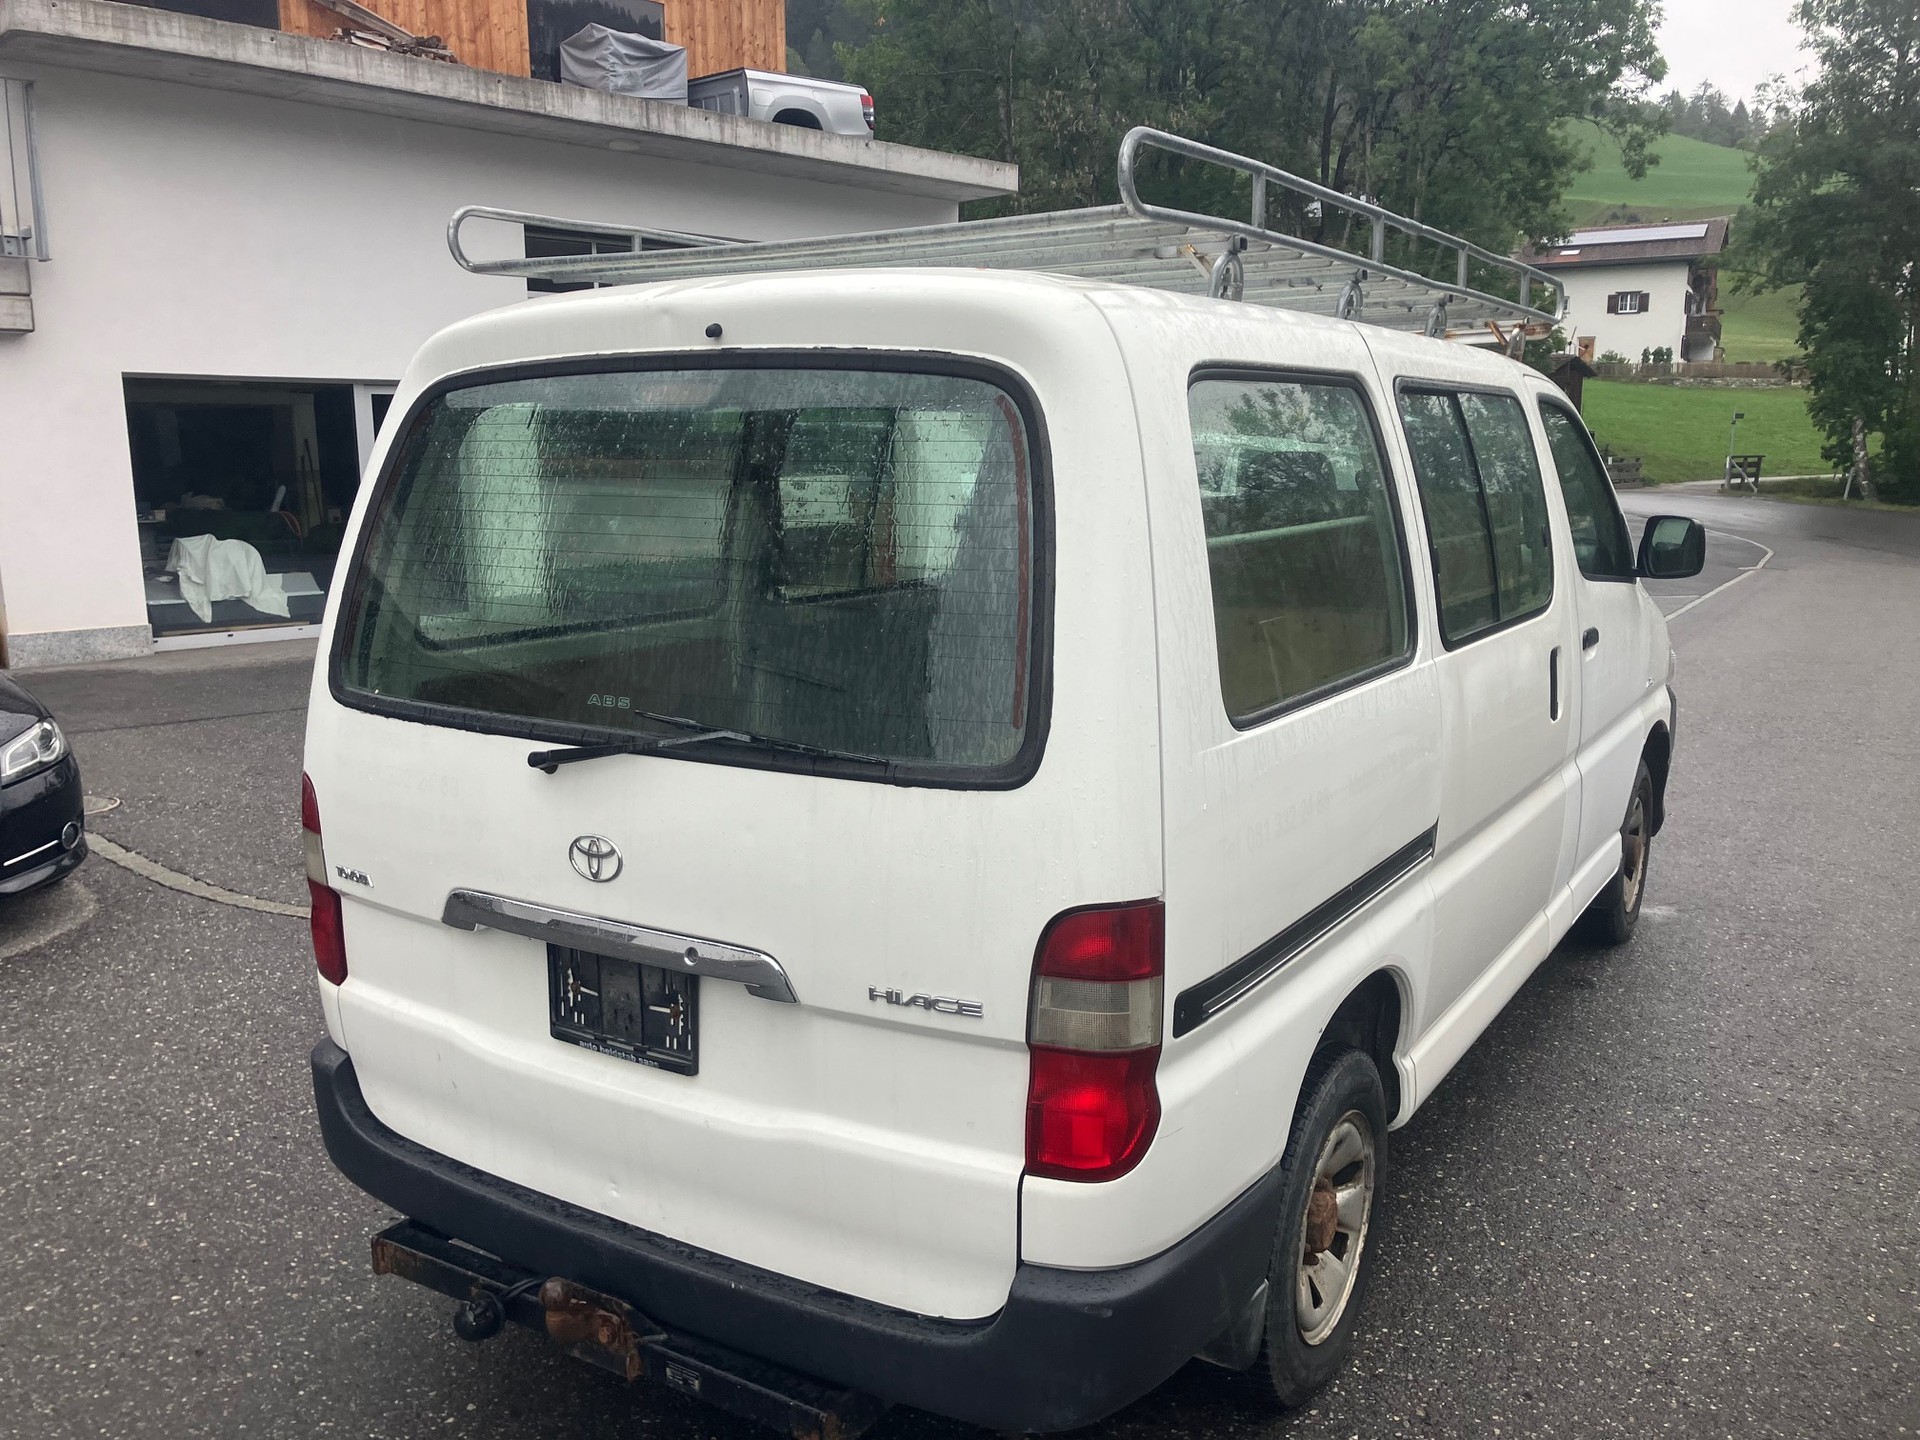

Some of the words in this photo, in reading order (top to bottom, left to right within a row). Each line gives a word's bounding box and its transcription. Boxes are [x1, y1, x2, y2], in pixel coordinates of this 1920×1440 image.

[587, 693, 631, 709] ABS
[868, 984, 983, 1019] HIACE
[579, 1040, 598, 1051] auto
